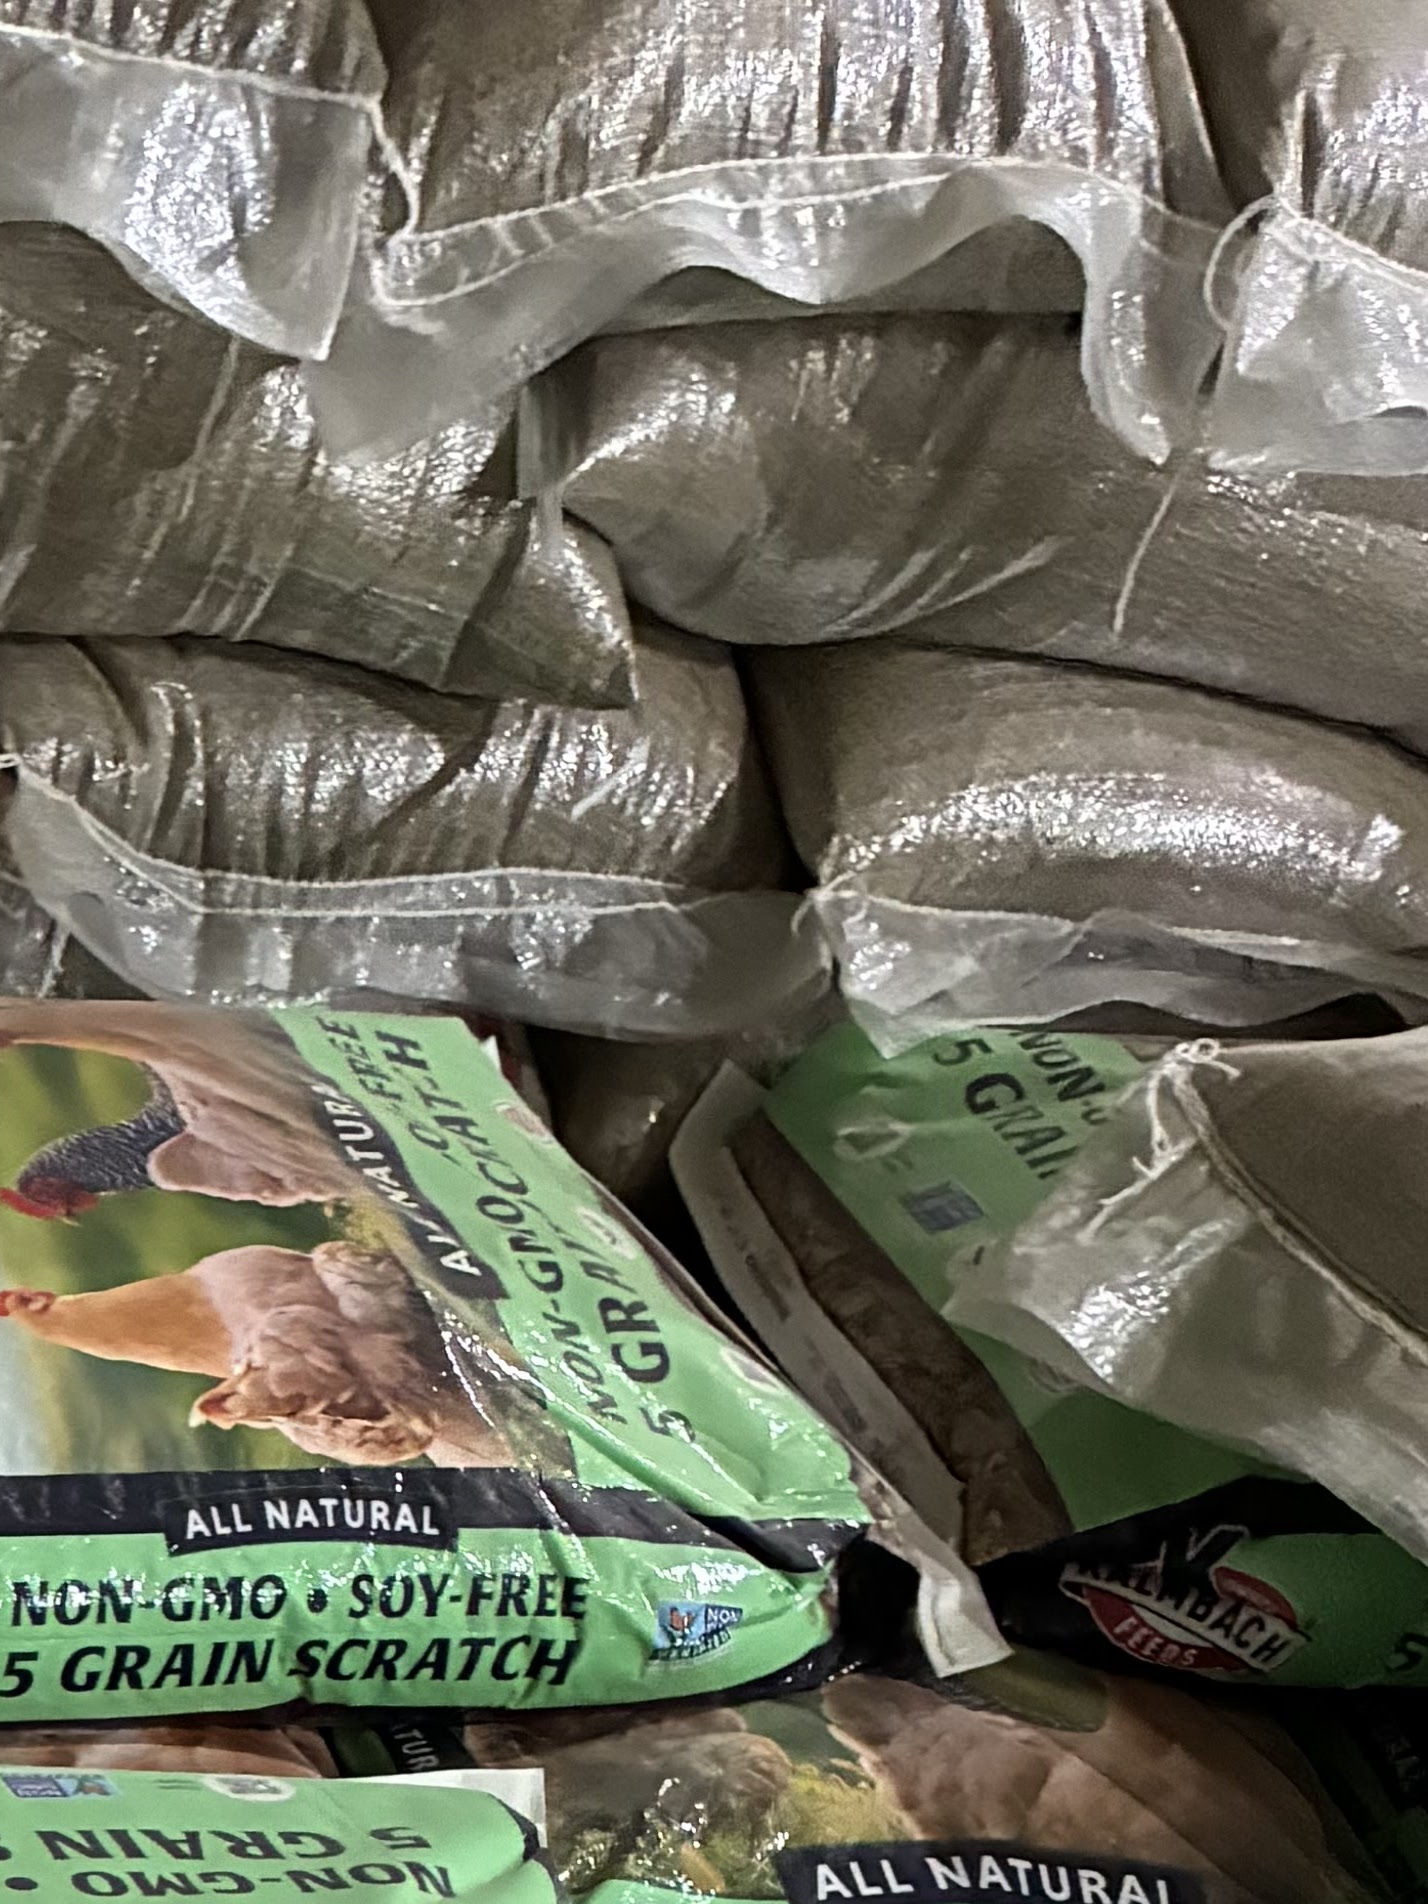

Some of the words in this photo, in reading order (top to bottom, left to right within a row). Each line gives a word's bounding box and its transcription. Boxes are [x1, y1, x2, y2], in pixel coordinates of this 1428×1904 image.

[932, 1037, 994, 1067] 5
[965, 1072, 1080, 1181] GRAI
[310, 1085, 420, 1210] NATUR
[185, 1505, 254, 1541] ALL
[265, 1498, 441, 1537] NATURAL
[10, 1573, 288, 1628] NON-GMO
[347, 1571, 591, 1622] SOY-FREE
[60, 1637, 275, 1693] GRAIN
[287, 1632, 585, 1687] SCRATCH
[1112, 1615, 1199, 1668] FEEDS
[33, 1828, 346, 1862] GRAIN
[370, 1826, 434, 1851] 5
[70, 1860, 458, 1899] NON-GMO
[814, 1856, 914, 1902] ALL
